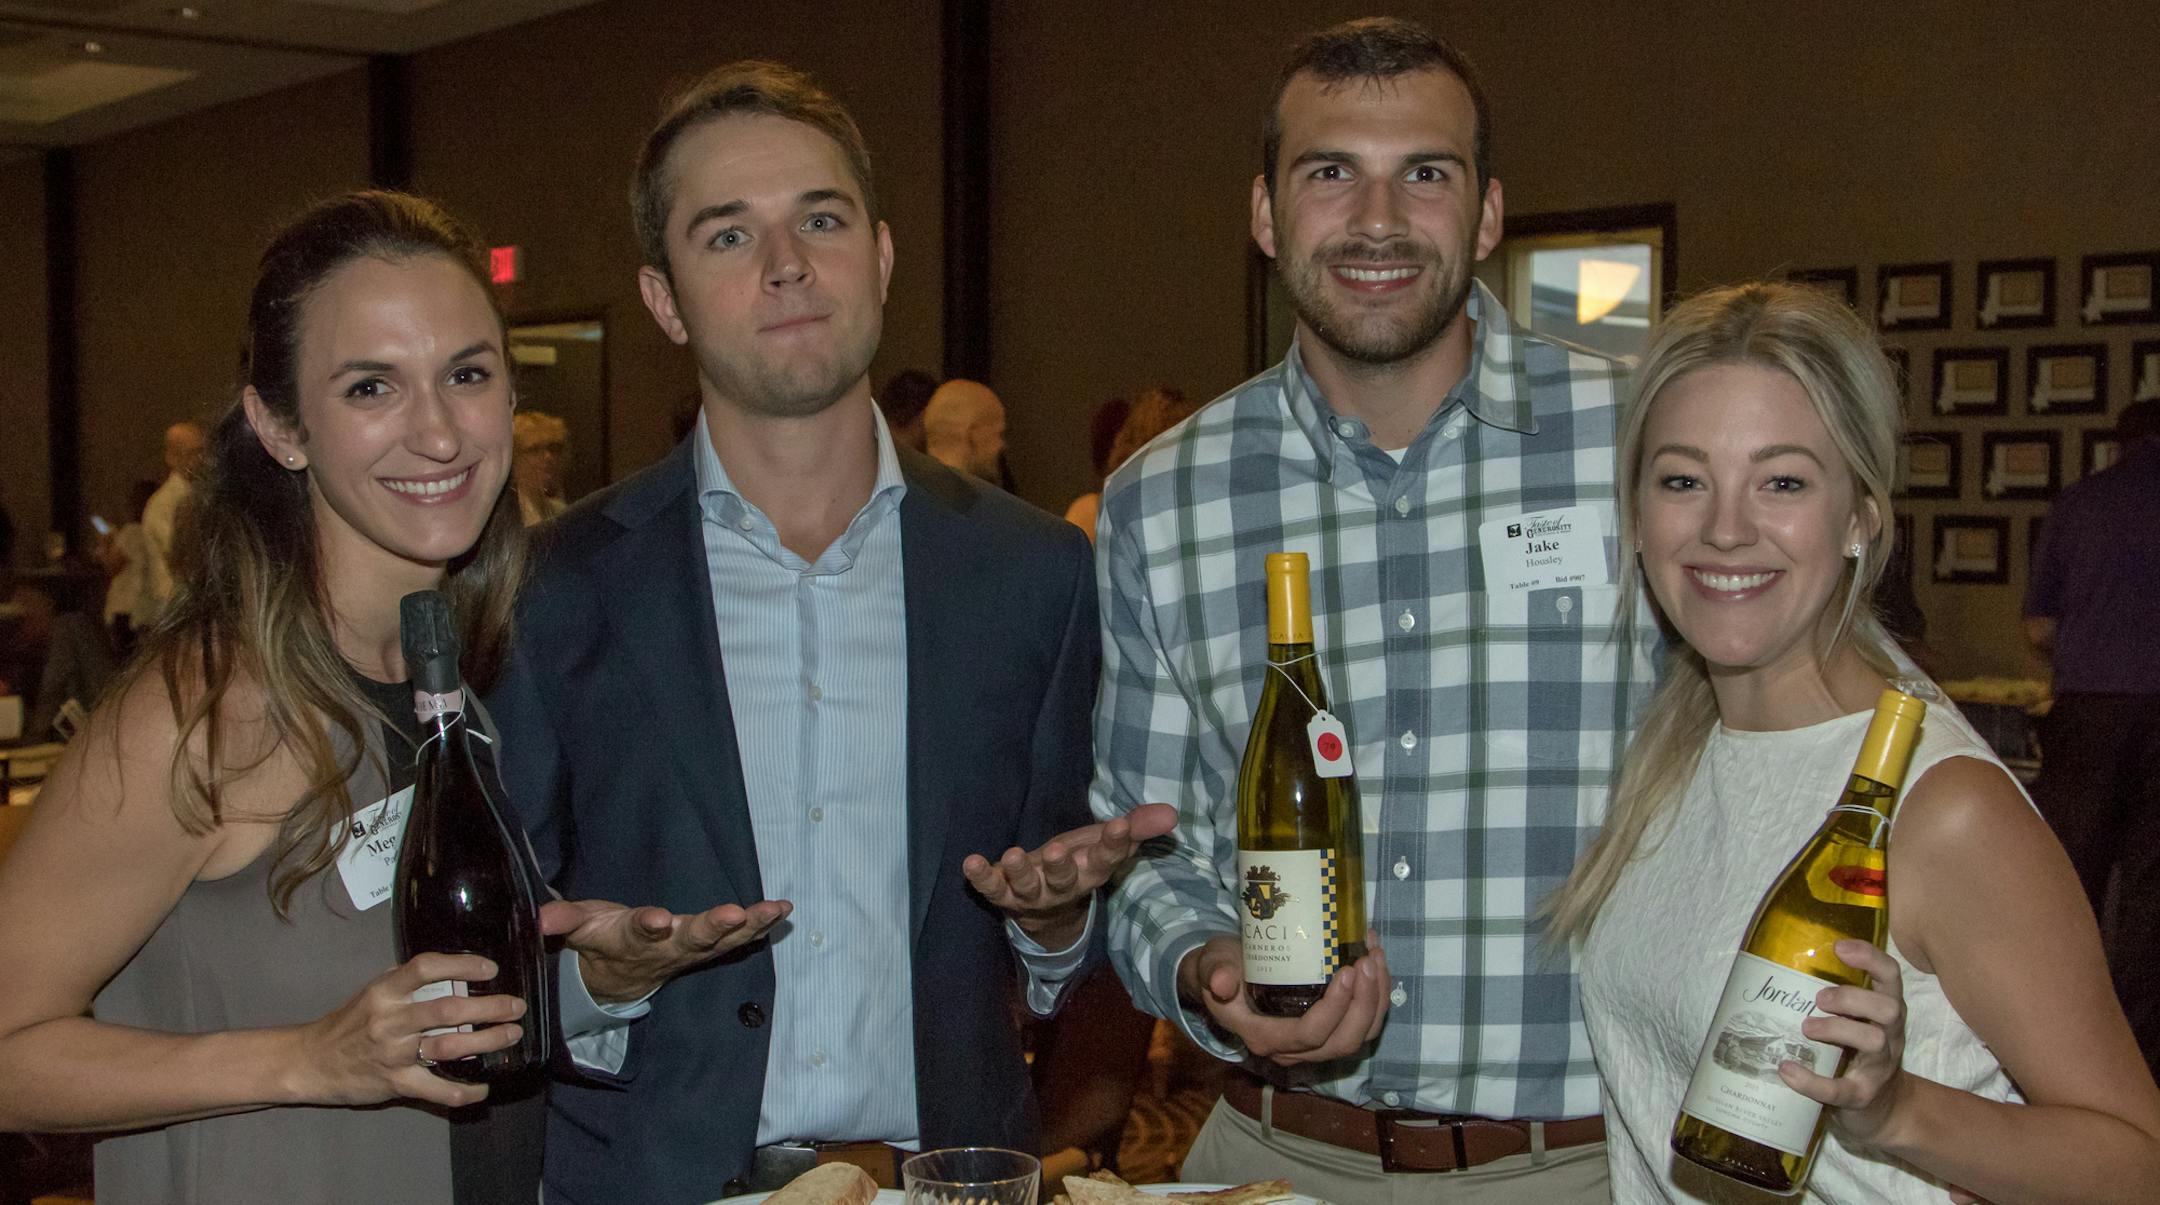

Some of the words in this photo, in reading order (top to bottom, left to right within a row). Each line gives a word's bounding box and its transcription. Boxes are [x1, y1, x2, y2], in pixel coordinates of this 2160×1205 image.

[1525, 540, 1560, 555] Jake
[1526, 555, 1563, 568] Housley
[1510, 581, 1529, 590] Table
[370, 886, 389, 899] Table
[1743, 975, 1816, 1017] Jordan
